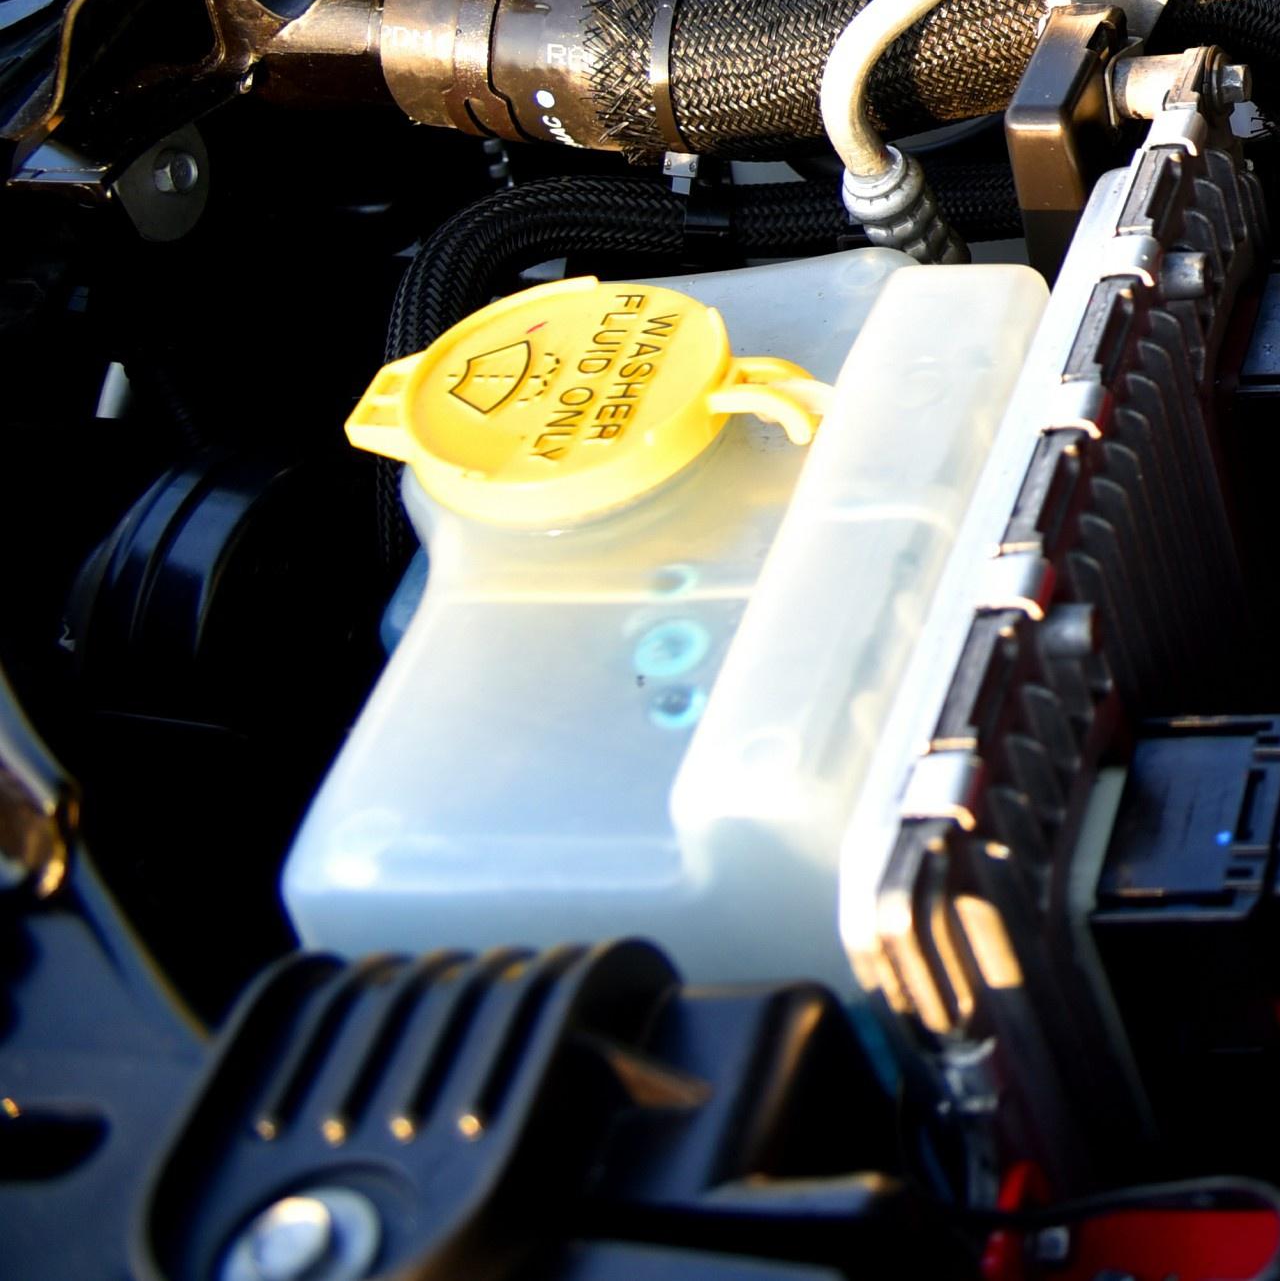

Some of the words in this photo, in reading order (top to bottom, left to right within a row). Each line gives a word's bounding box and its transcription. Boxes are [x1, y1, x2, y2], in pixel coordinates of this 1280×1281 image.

[577, 294, 646, 374] FLUID
[584, 313, 679, 440] WASHER
[529, 386, 595, 461] ONLY
